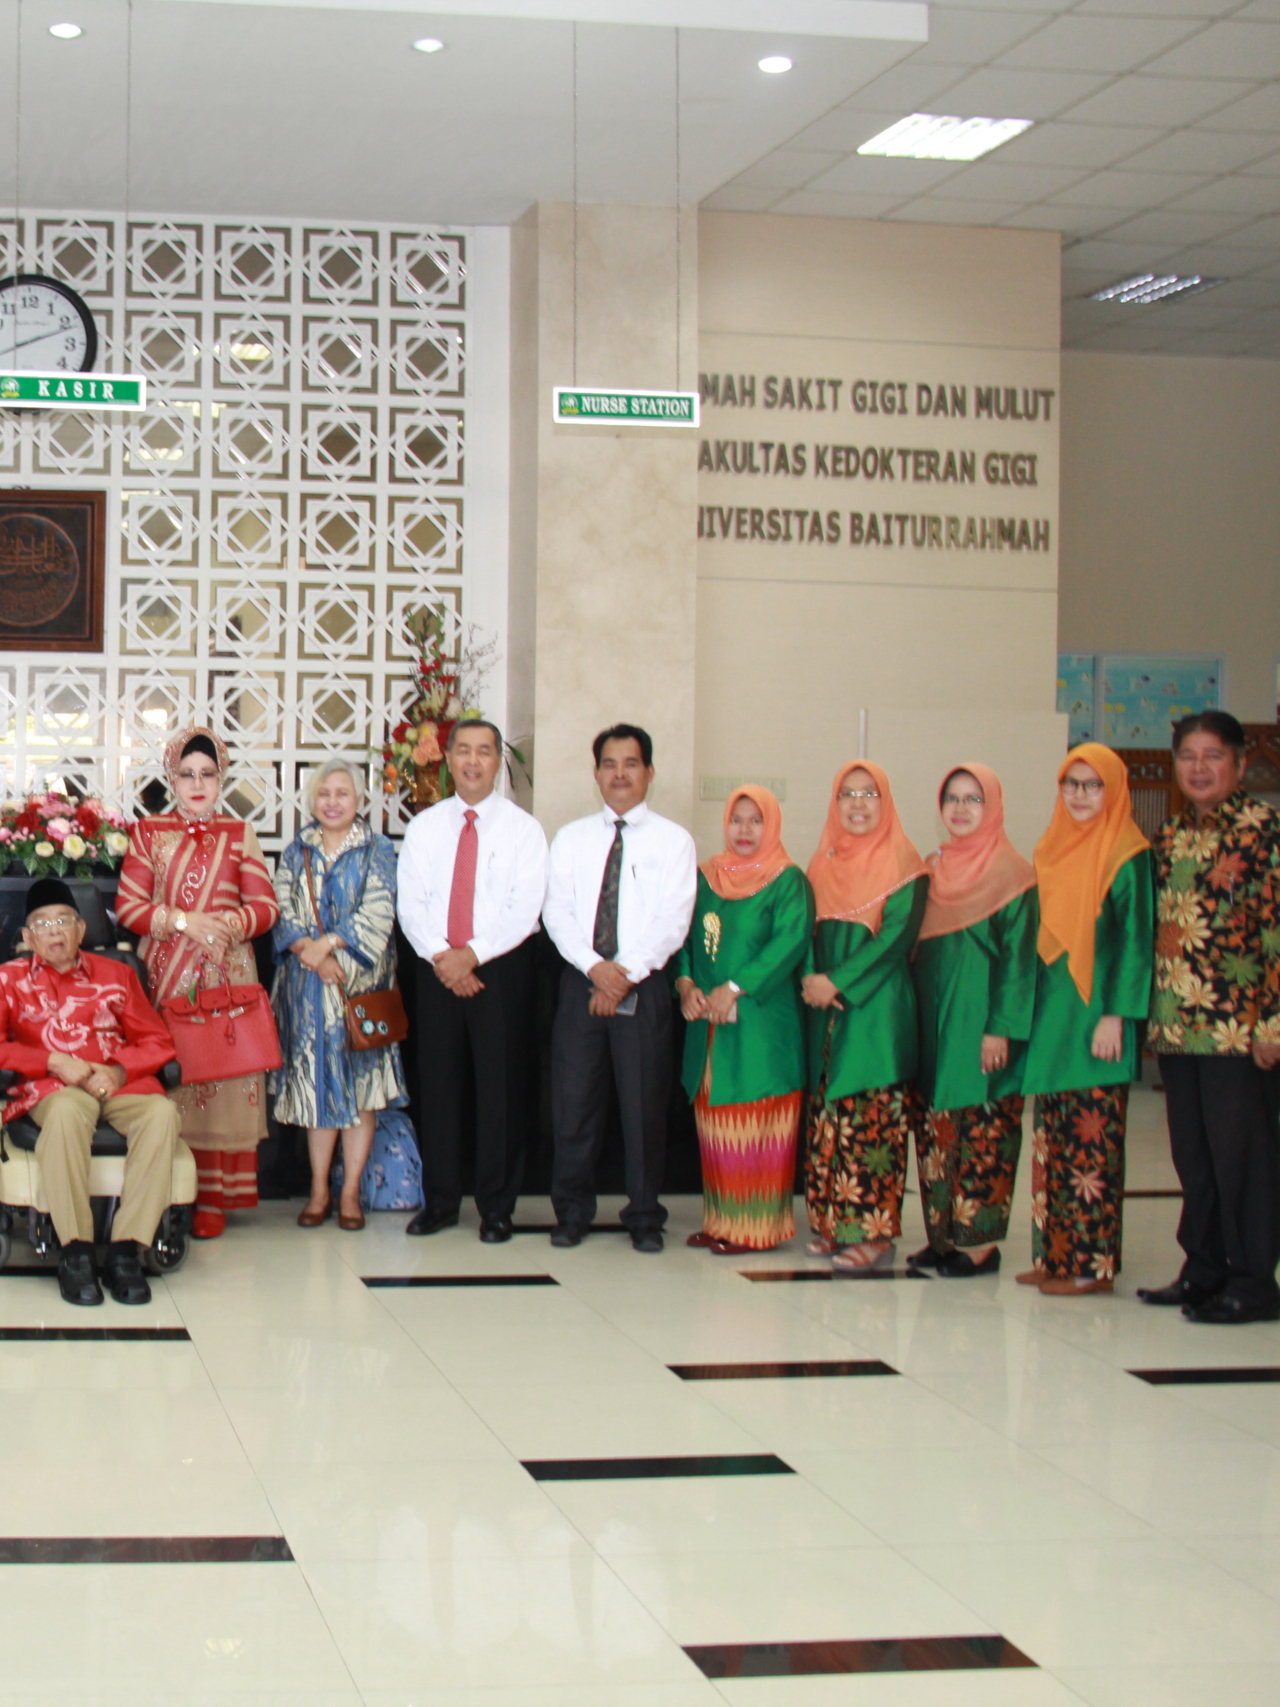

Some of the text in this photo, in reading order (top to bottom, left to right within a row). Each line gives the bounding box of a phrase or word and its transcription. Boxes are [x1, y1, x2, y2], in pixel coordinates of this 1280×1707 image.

[2, 303, 16, 315] 11
[21, 295, 39, 309] 12
[47, 302, 56, 316] 1
[60, 316, 72, 331] 2
[64, 337, 76, 352] 3
[56, 356, 68, 369] 4
[38, 380, 114, 399] KASIR
[763, 375, 843, 412] SAKIT
[851, 379, 908, 415] GIGI
[916, 382, 966, 418] DAN
[974, 386, 1055, 421] MULUT
[581, 396, 690, 417] NURSE STATION
[814, 443, 976, 483] KEDOKTERAN
[983, 451, 1038, 487] GIGI
[849, 511, 1050, 552] BAITURRAHMAH
